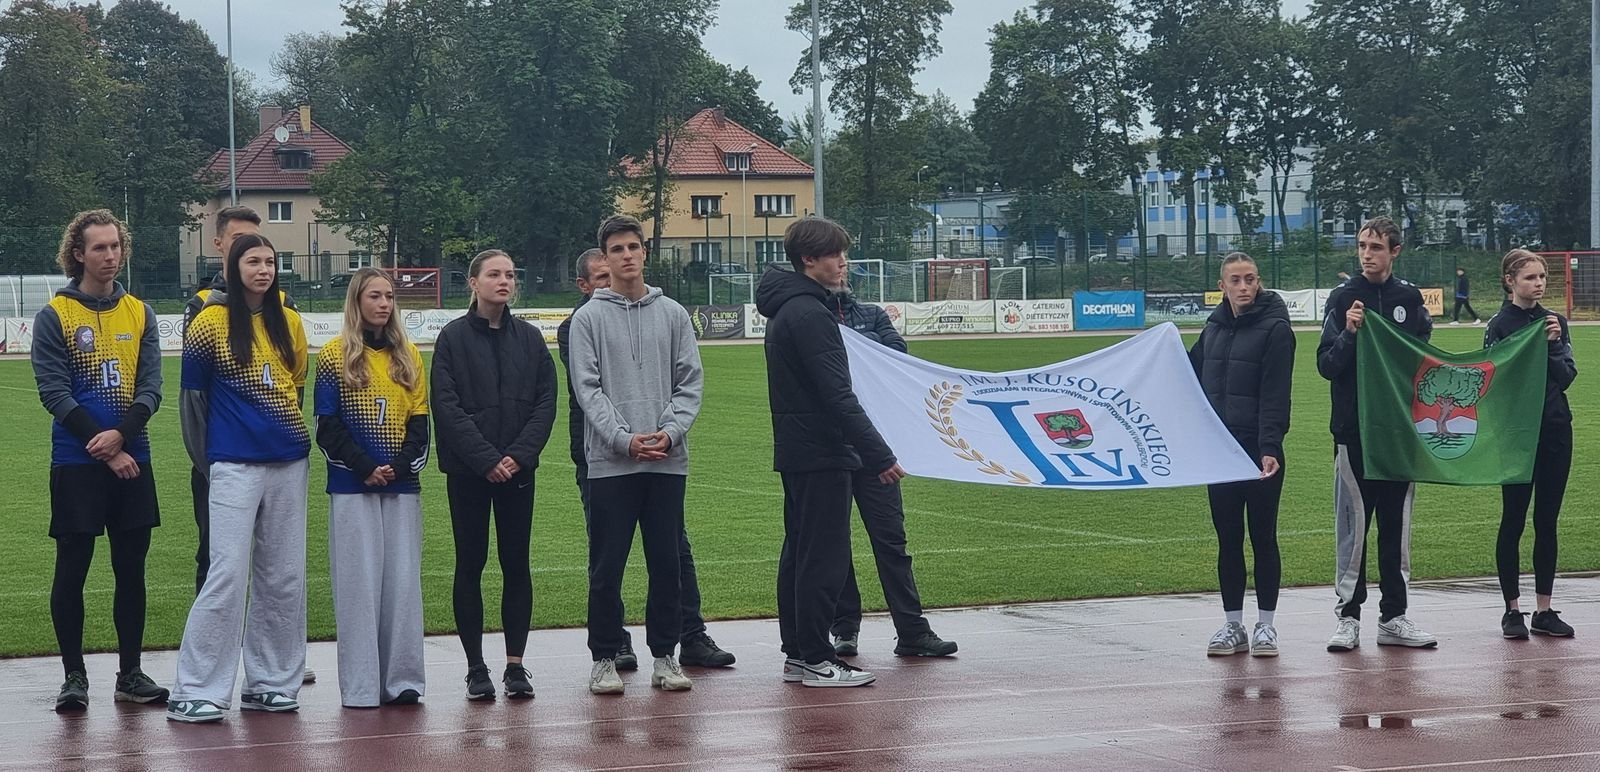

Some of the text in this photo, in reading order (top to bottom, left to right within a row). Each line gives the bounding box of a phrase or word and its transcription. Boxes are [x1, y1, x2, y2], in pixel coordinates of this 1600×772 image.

[1082, 303, 1136, 315] DECATHLON
[101, 359, 121, 388] 15
[262, 363, 274, 390] 4
[375, 398, 387, 425] 7
[1027, 372, 1171, 477] KUSOCIŃSKIEGO
